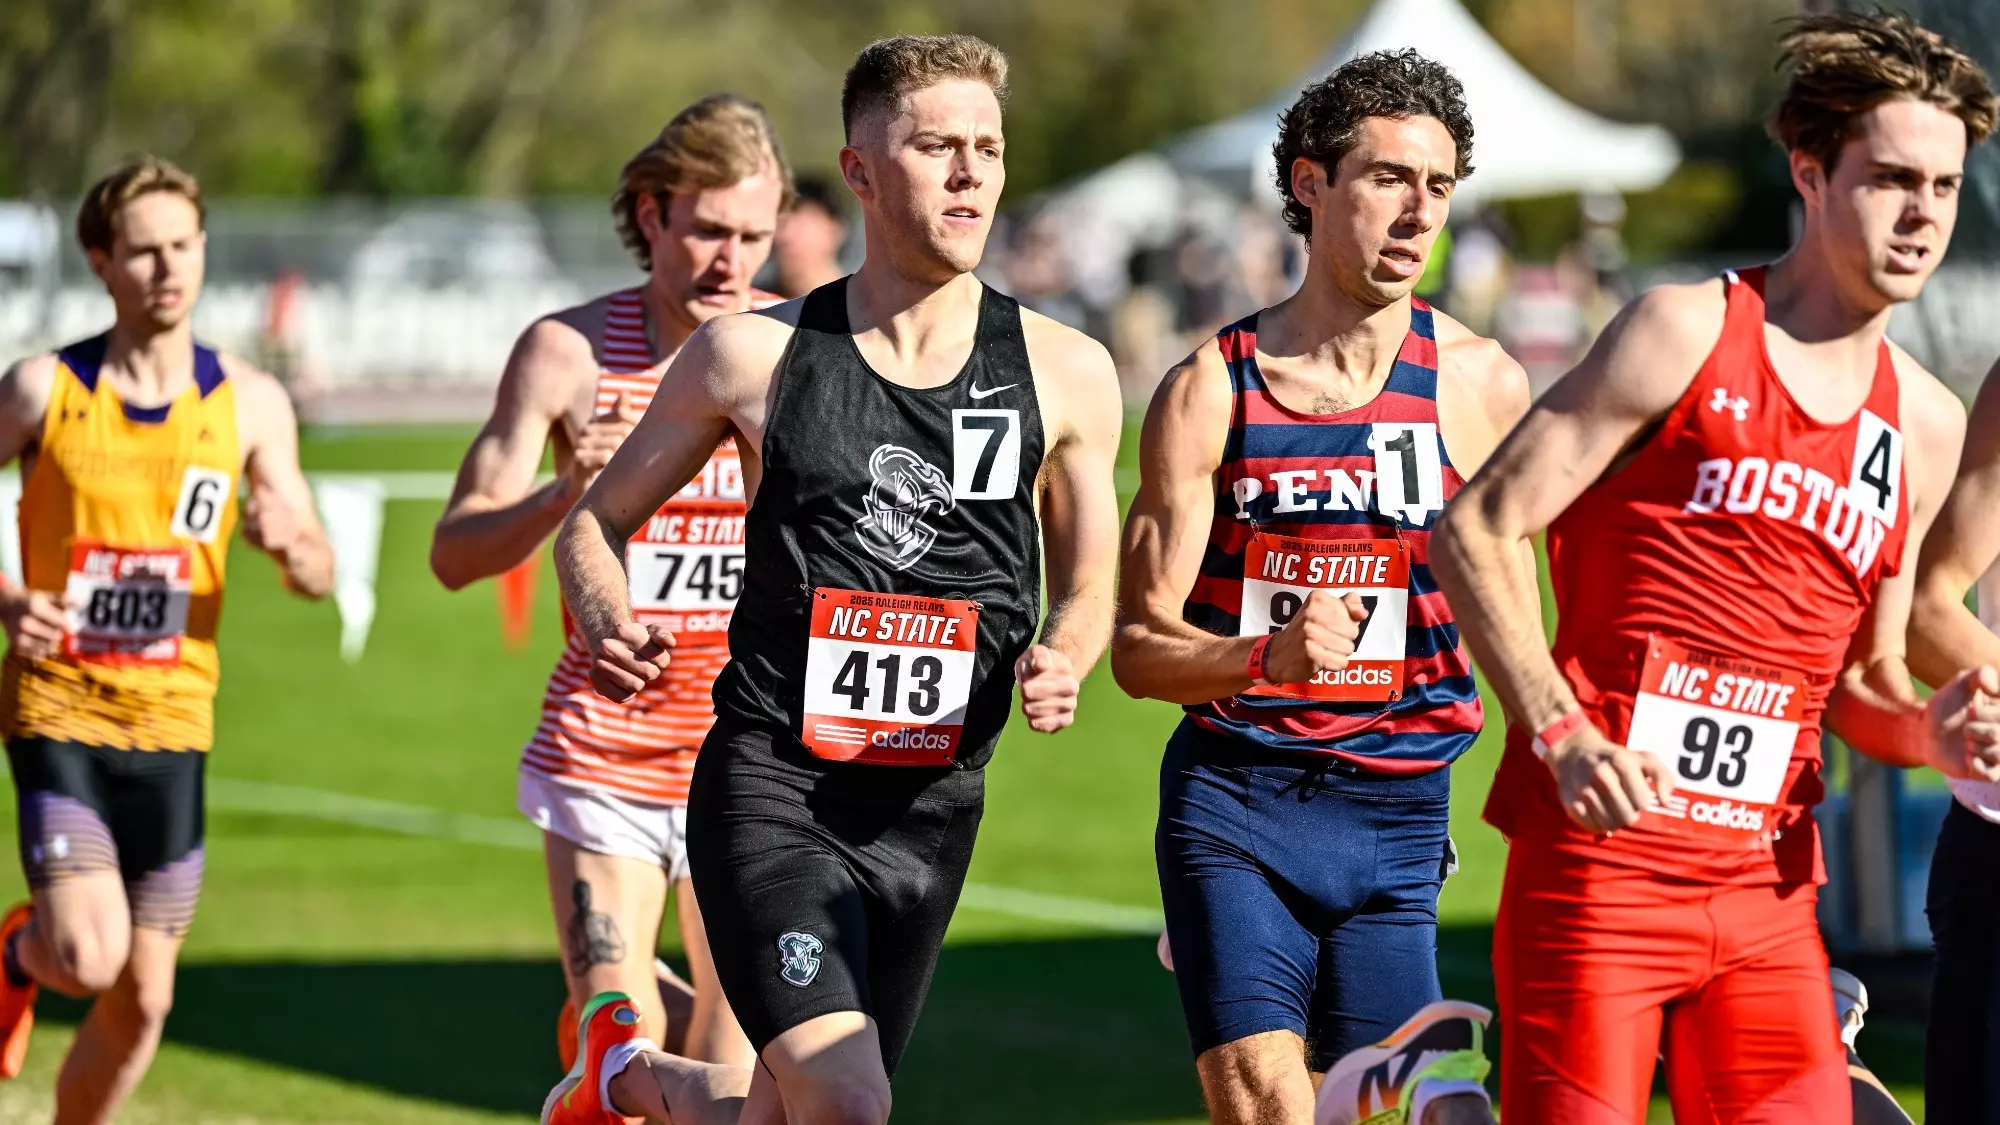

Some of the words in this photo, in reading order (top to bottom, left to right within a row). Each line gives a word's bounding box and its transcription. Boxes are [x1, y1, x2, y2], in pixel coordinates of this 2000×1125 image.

[961, 415, 1010, 493] 7
[1385, 429, 1421, 504] 1
[1860, 428, 1892, 510] 4
[184, 479, 219, 534] 6
[1232, 468, 1430, 527] PEN
[1684, 457, 1886, 579] BOSTON
[646, 514, 685, 542] NC
[686, 515, 746, 544] STAT
[1280, 539, 1304, 551] 2025
[1304, 543, 1340, 554] RALEIGH
[1342, 543, 1373, 553] RELAYS
[655, 553, 746, 601] 745
[1262, 550, 1302, 582] NC
[1306, 555, 1391, 585] STATE
[89, 588, 168, 630] 603
[828, 605, 873, 639] NC
[875, 610, 962, 646] STATE
[850, 594, 874, 606] 2025
[875, 598, 912, 610] RALEIGH
[913, 600, 945, 613] RELAYS
[1269, 591, 1379, 653] 97
[832, 649, 943, 717] 413
[1659, 660, 1710, 701] NC
[1709, 672, 1796, 718] STATE
[871, 726, 950, 750] adidas
[1677, 716, 1754, 788] 93
[1689, 799, 1765, 831] adidas
